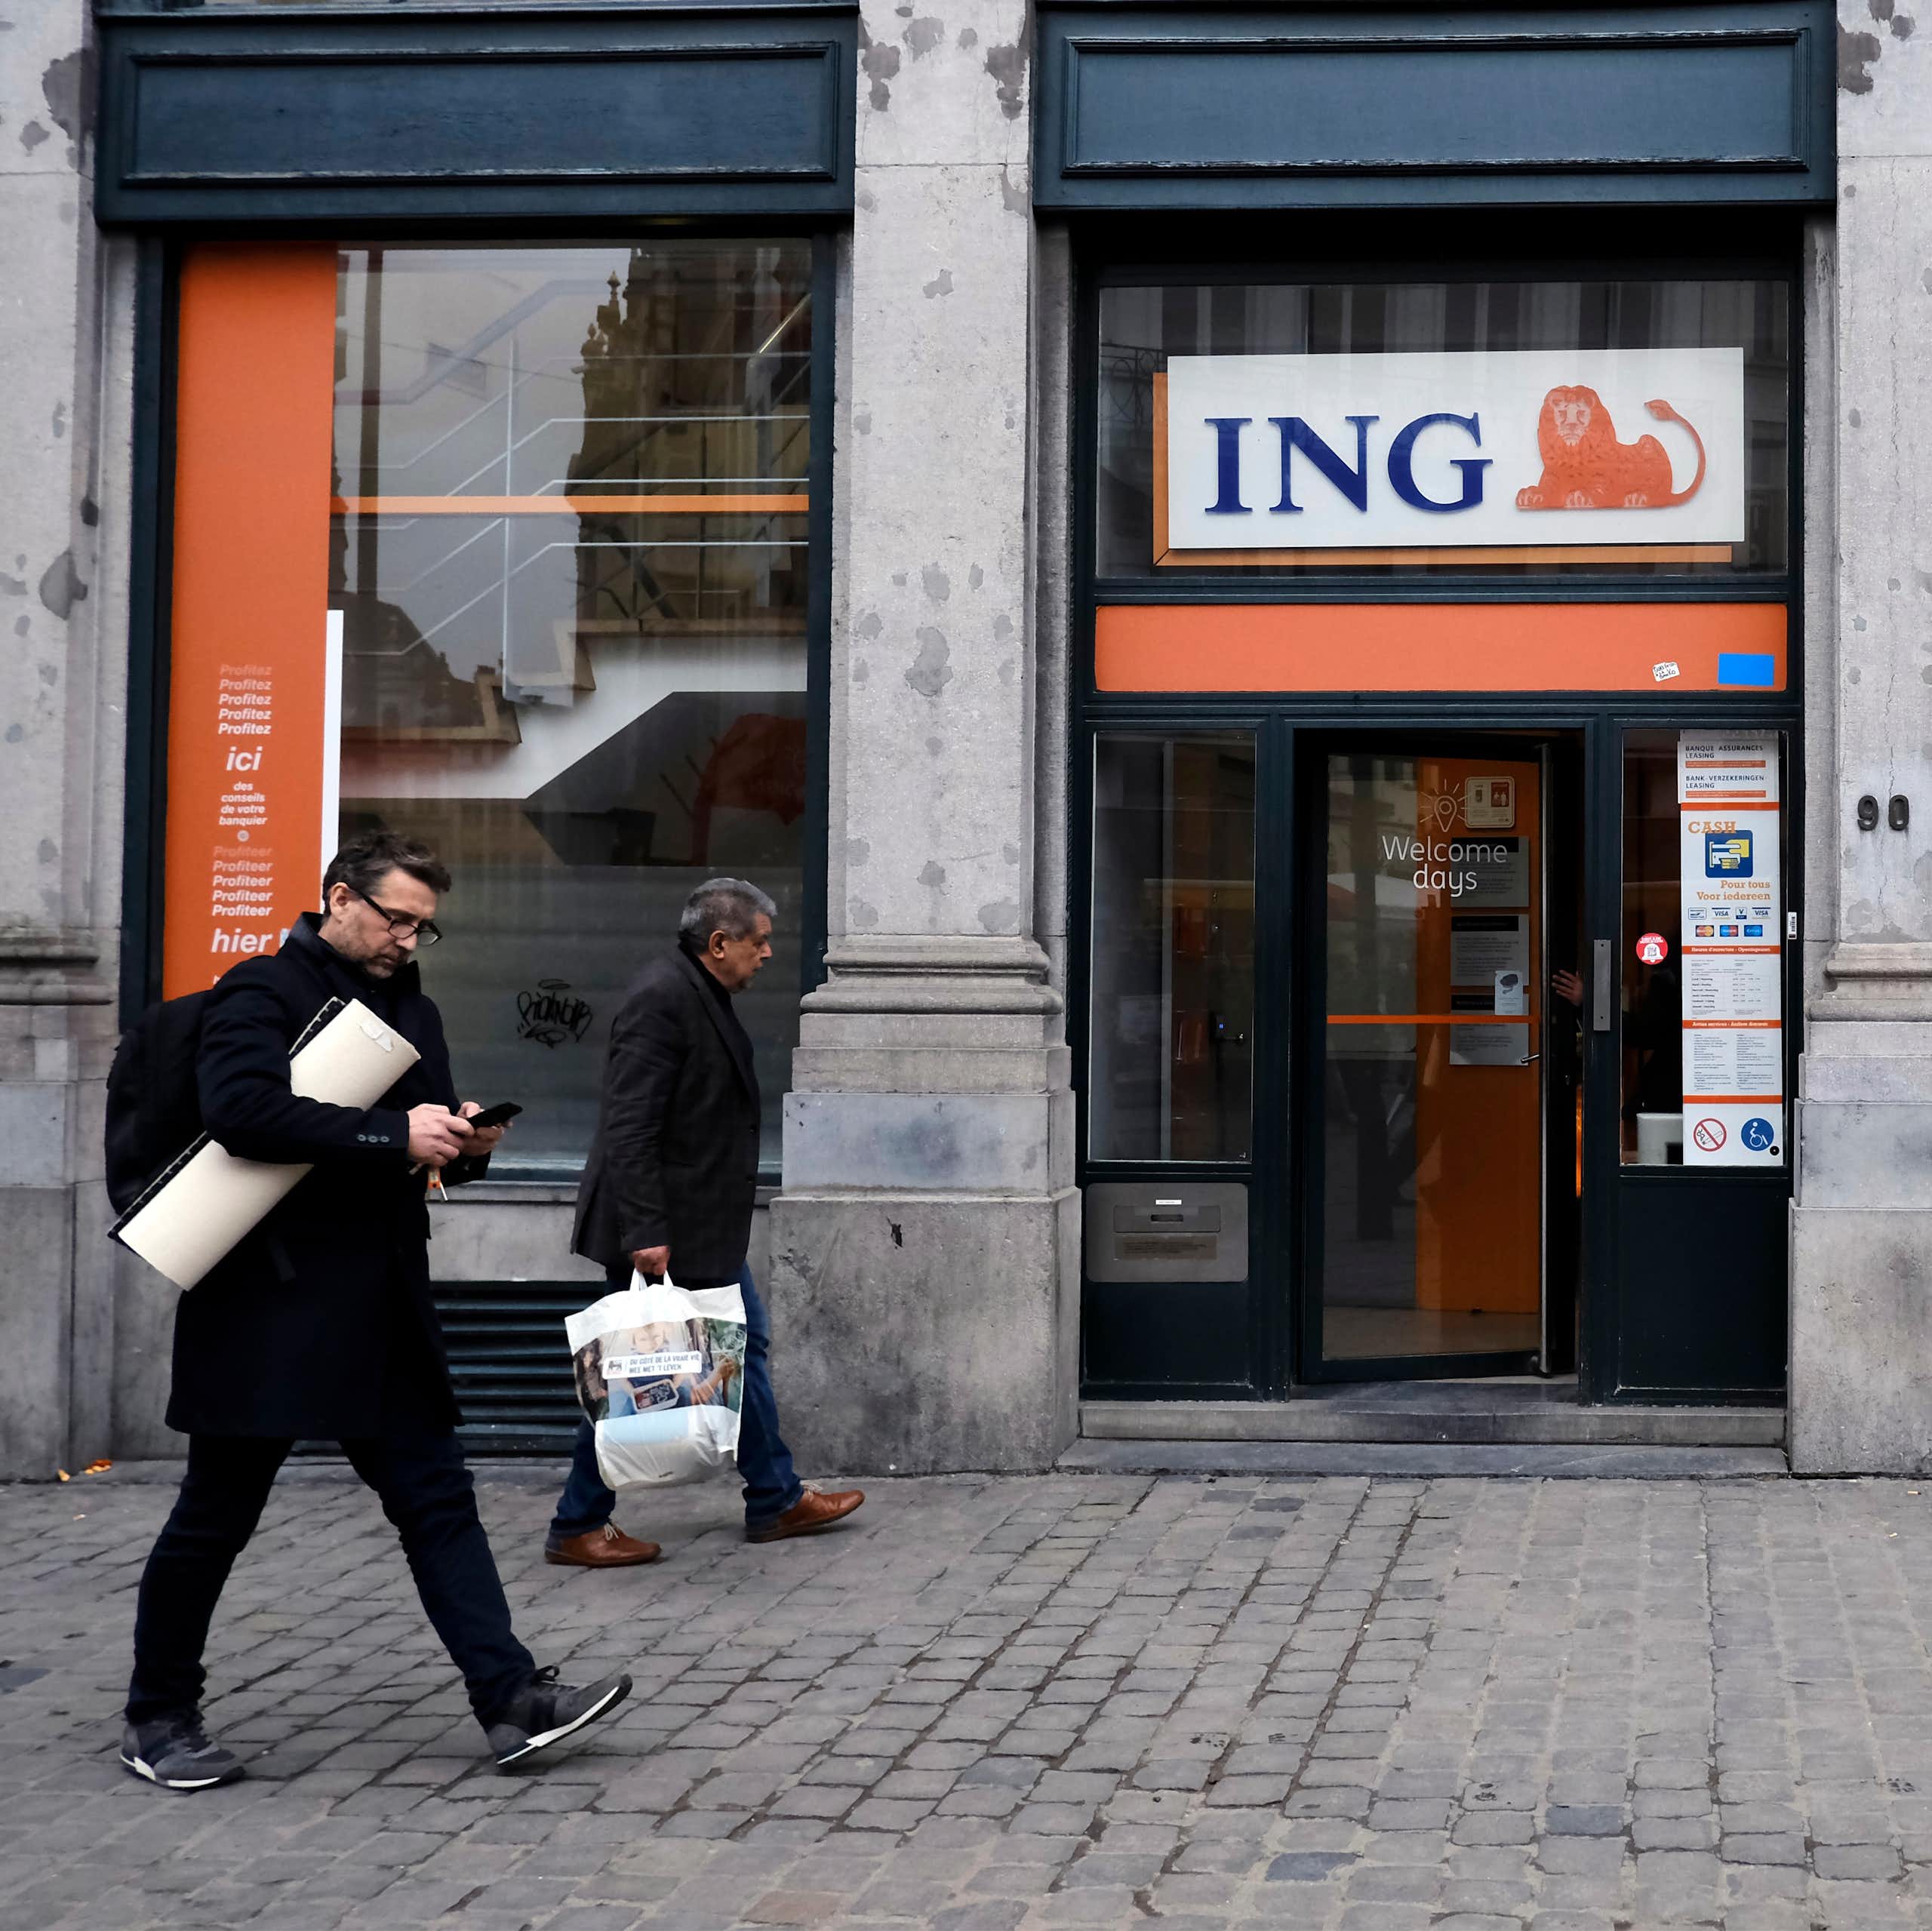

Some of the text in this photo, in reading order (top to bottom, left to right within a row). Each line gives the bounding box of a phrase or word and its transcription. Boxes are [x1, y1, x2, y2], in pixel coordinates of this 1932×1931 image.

[1204, 412, 1493, 513] ING
[219, 678, 272, 690] Profitez
[219, 693, 272, 705] Profitez
[219, 708, 272, 720] Profitez
[219, 723, 272, 734] Profitez
[226, 746, 263, 771] ici
[233, 781, 254, 791] des
[221, 793, 266, 802] conseils
[220, 804, 265, 813] de votre
[1857, 795, 1909, 831] 90
[219, 816, 268, 826] banquier
[1688, 821, 1737, 834] CASH
[213, 846, 272, 857] Profiteer
[1382, 835, 1508, 863] Welcome
[213, 860, 273, 872] Profiteer
[212, 875, 273, 887] Profiteer
[1413, 863, 1478, 897] days
[1721, 880, 1745, 888] Pour
[212, 890, 273, 902] Profiteer
[1697, 892, 1770, 900] Voor iedereen
[211, 905, 273, 917] Profiteer
[211, 928, 273, 953] hier
